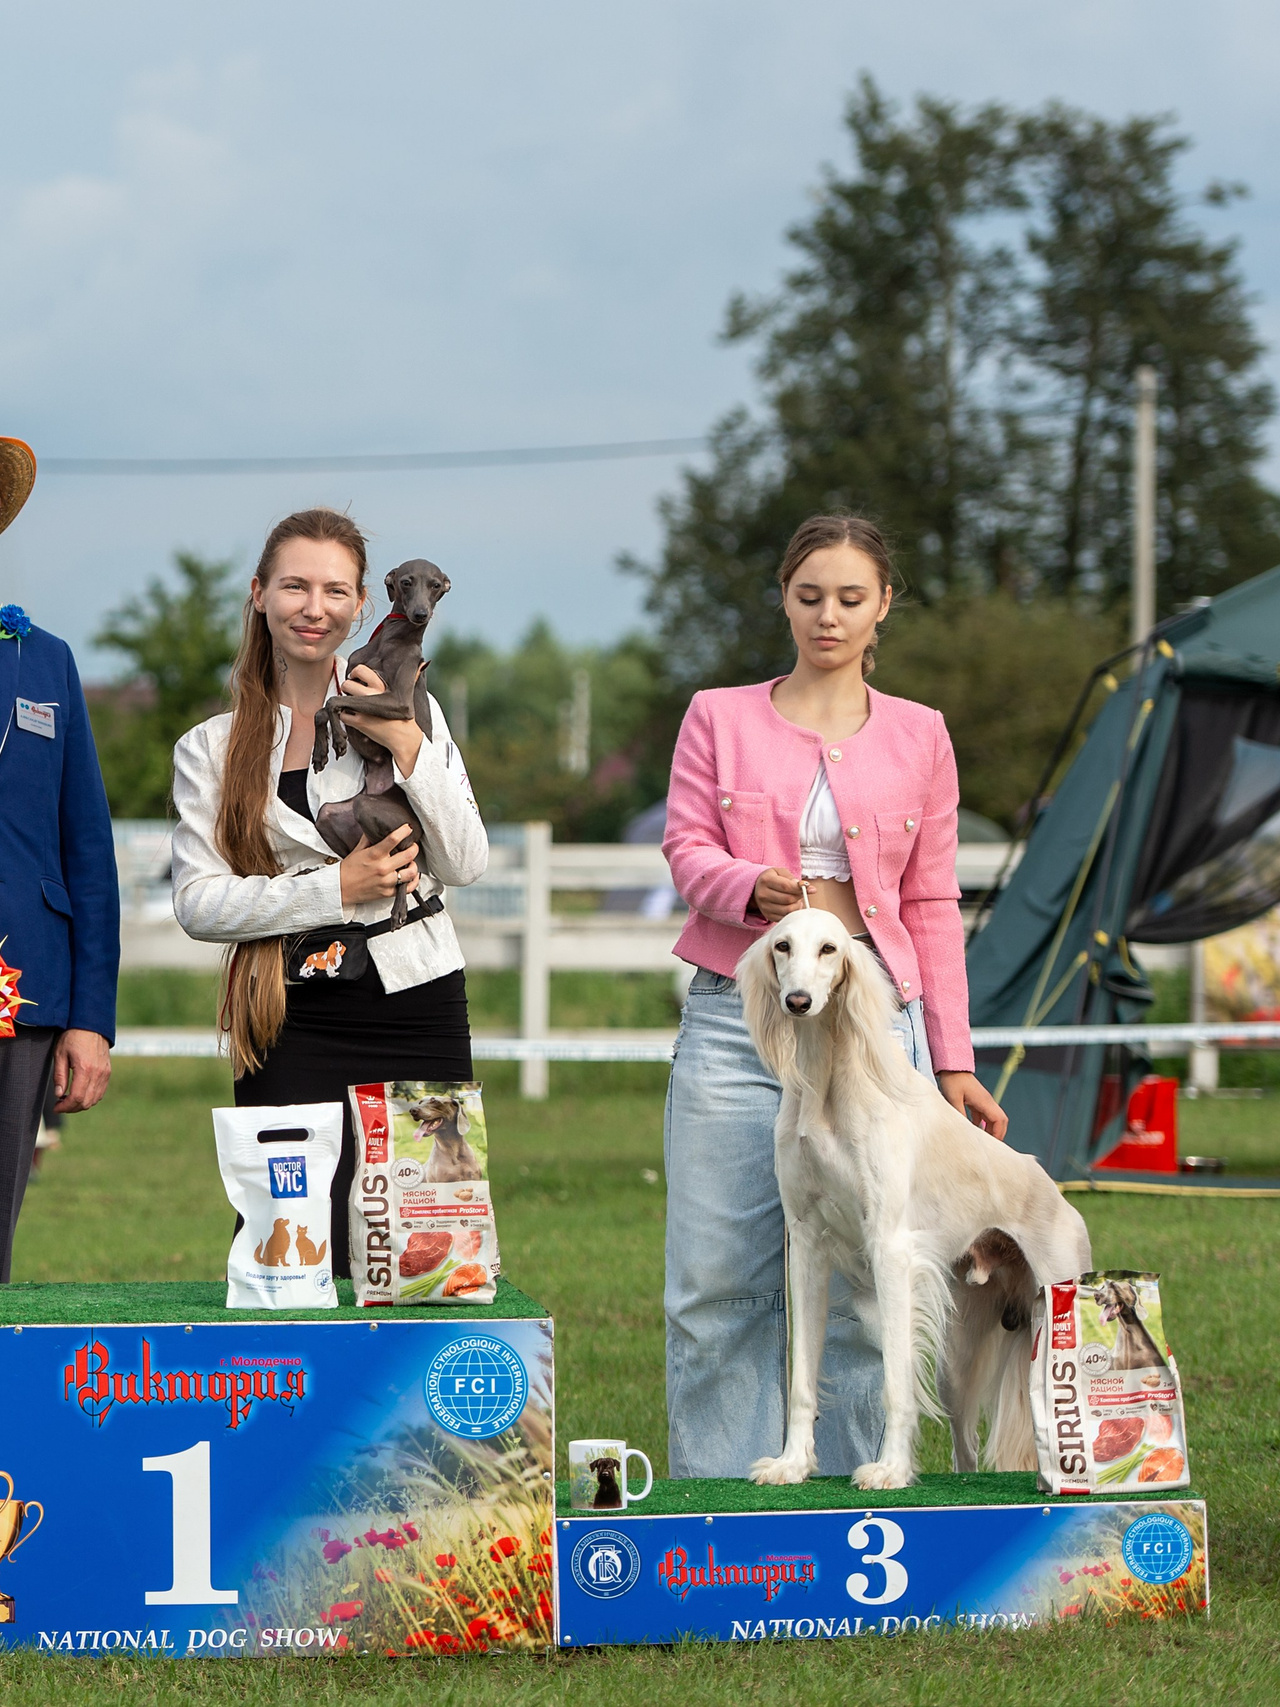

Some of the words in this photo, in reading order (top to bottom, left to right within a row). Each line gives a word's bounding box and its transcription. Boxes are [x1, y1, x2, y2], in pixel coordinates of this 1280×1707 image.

[273, 1161, 302, 1172] DOCTOR
[397, 1167, 420, 1177] 40%
[274, 1170, 303, 1193] VIC
[402, 1188, 437, 1198] МЯСНОЙ
[402, 1197, 436, 1205] РАЦИОН
[361, 1174, 392, 1288] SIRIUS
[1053, 1322, 1072, 1332] ADULT
[220, 1358, 228, 1366] г.
[231, 1356, 302, 1368] Молодечно
[434, 1338, 502, 1370] CYNOLOGIQUE
[1085, 1353, 1107, 1365] 40%
[64, 1328, 308, 1430] Виктория
[454, 1377, 496, 1394] FCI
[491, 1349, 523, 1430] INTERNATIONALE
[1090, 1376, 1124, 1385] МЯСНОЙ
[1090, 1385, 1124, 1393] РАЦИОН
[428, 1371, 461, 1430] FEDERATION
[1052, 1361, 1087, 1475] SIRIUS
[141, 1440, 240, 1606] 1
[1128, 1516, 1174, 1538] CYNOLOGIQUE
[765, 1554, 812, 1562] Молодечно
[846, 1517, 909, 1606] 3
[1125, 1538, 1148, 1579] FEDERATION
[1168, 1523, 1190, 1578] INTERNATIONALE
[658, 1536, 816, 1602] Виктория
[731, 1616, 868, 1640] NATIONAL
[955, 1612, 1037, 1633] SHOW
[37, 1630, 175, 1650] NATIONAL
[186, 1629, 248, 1649] DOG
[259, 1627, 343, 1648] SHOW
